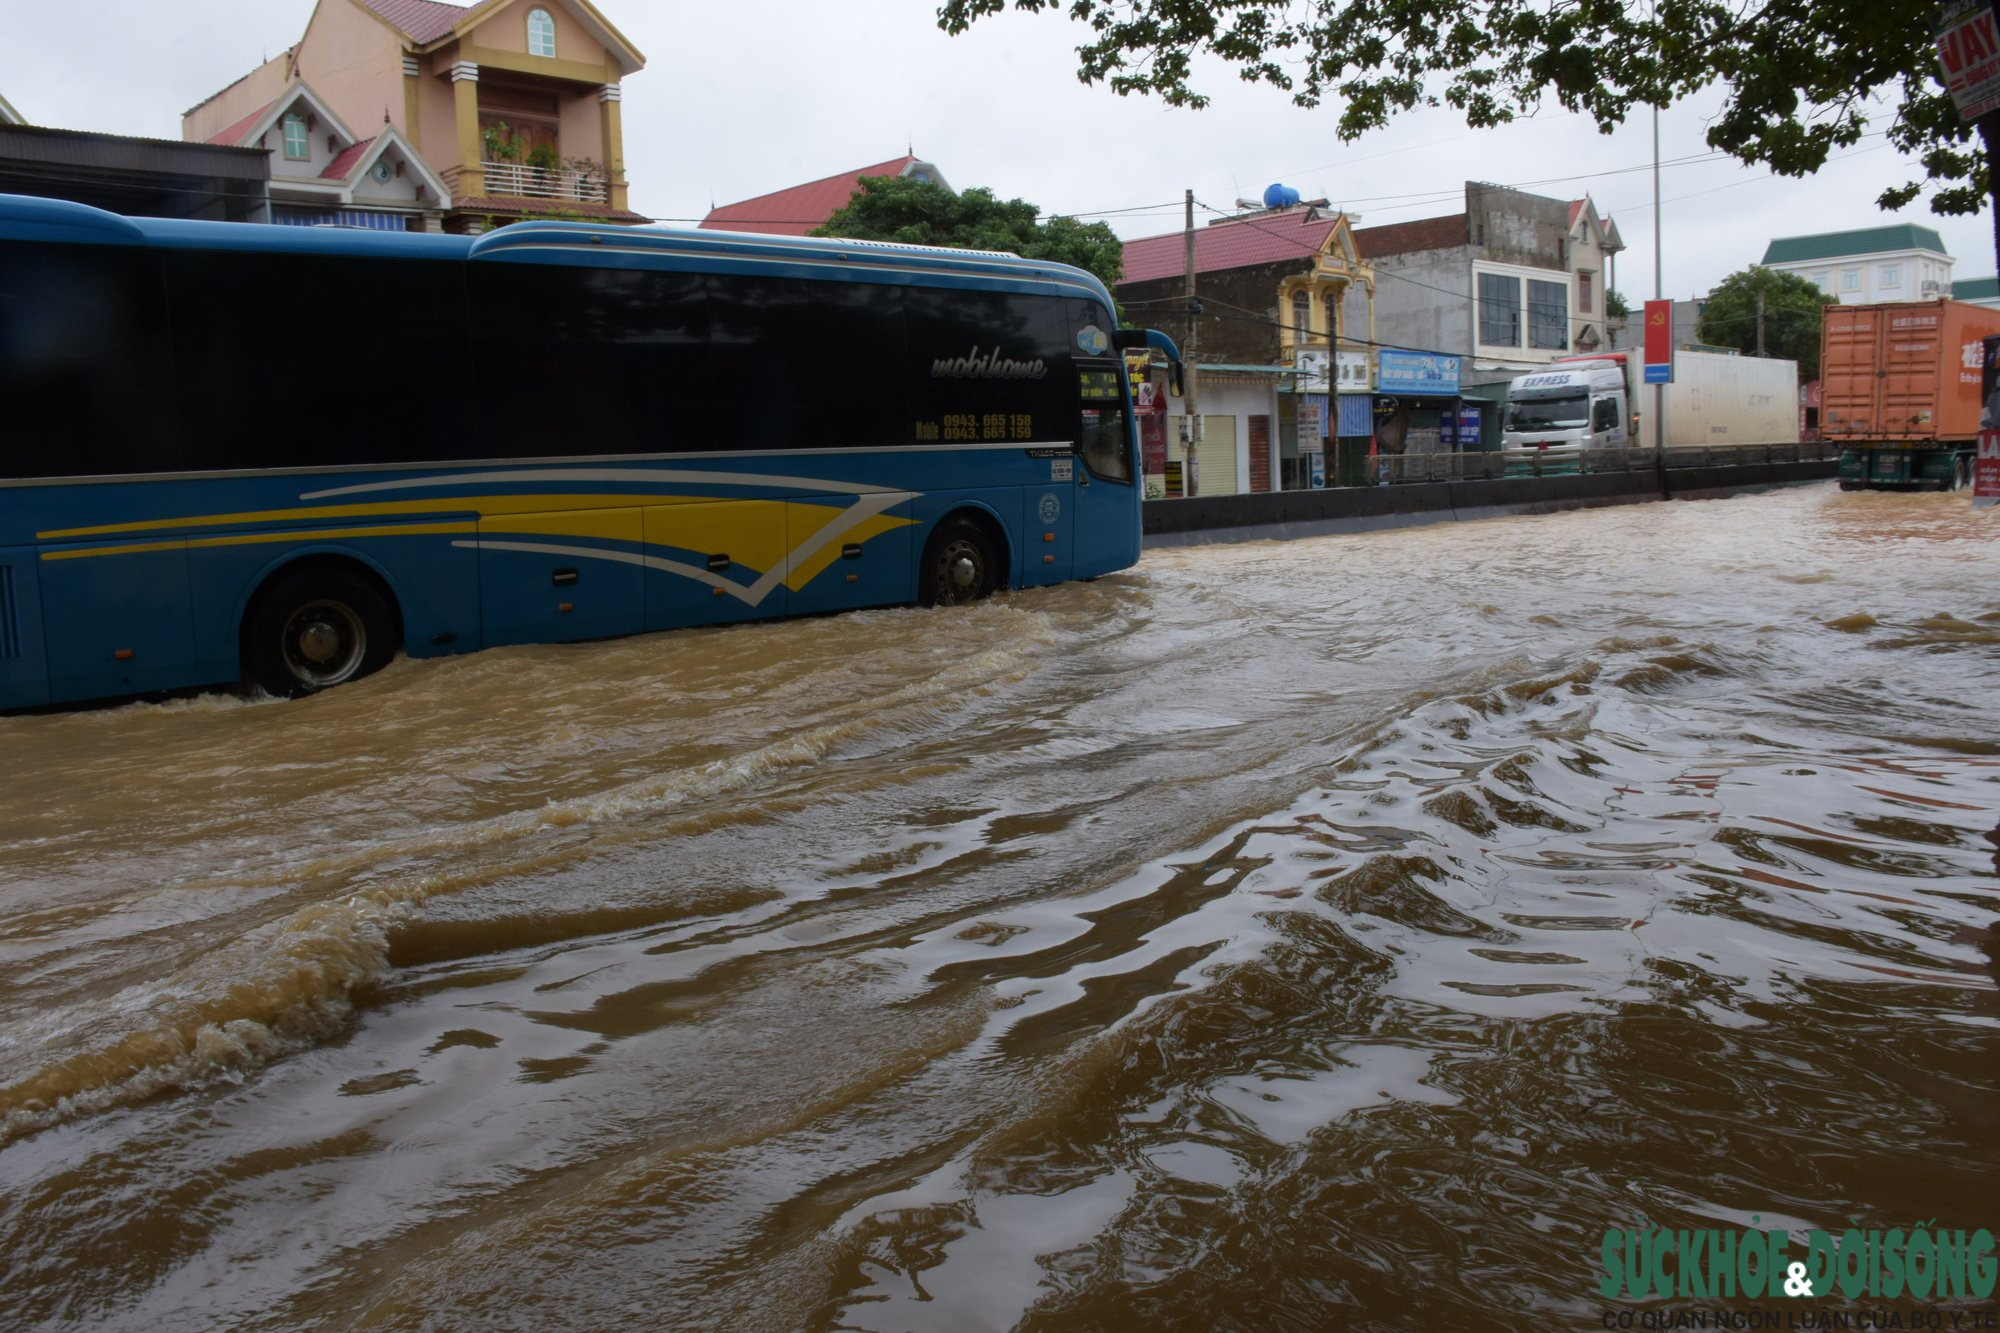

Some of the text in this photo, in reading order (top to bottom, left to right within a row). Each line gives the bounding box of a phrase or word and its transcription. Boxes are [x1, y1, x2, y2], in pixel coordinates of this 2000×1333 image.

[1938, 13, 1997, 73] VAY
[931, 345, 1048, 379] mobihome
[1522, 375, 1571, 387] EXPRESS
[944, 414, 1032, 427] 0943. 665 158
[916, 421, 939, 440] Mobile
[944, 426, 1032, 440] 0943. 665 159
